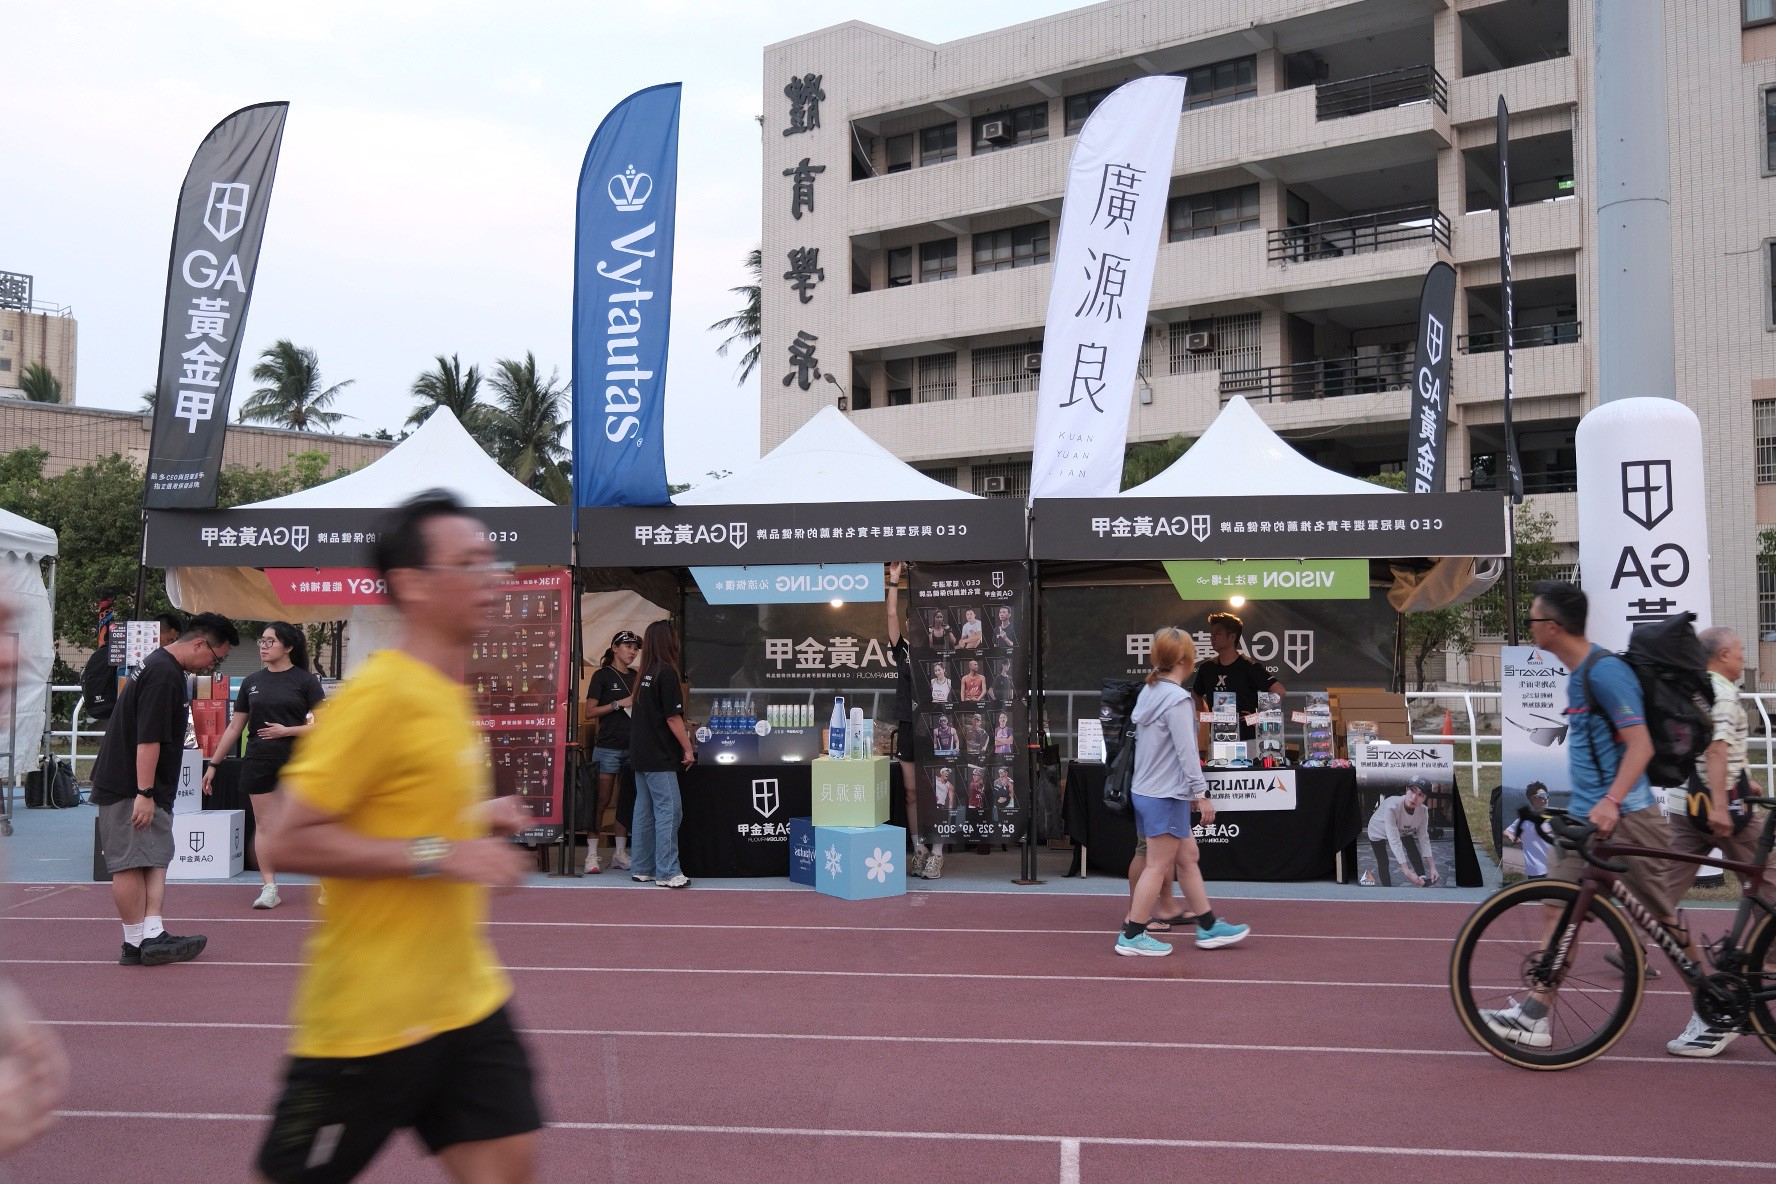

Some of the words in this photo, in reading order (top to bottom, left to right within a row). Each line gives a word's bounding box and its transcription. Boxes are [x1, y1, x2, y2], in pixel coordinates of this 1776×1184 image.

[182, 249, 246, 293] GA
[1059, 163, 1147, 413] 廣源良
[174, 296, 230, 434] 黃金甲
[596, 220, 656, 444] Vytautas
[1418, 367, 1442, 412] GA
[1049, 468, 1086, 478] IAN
